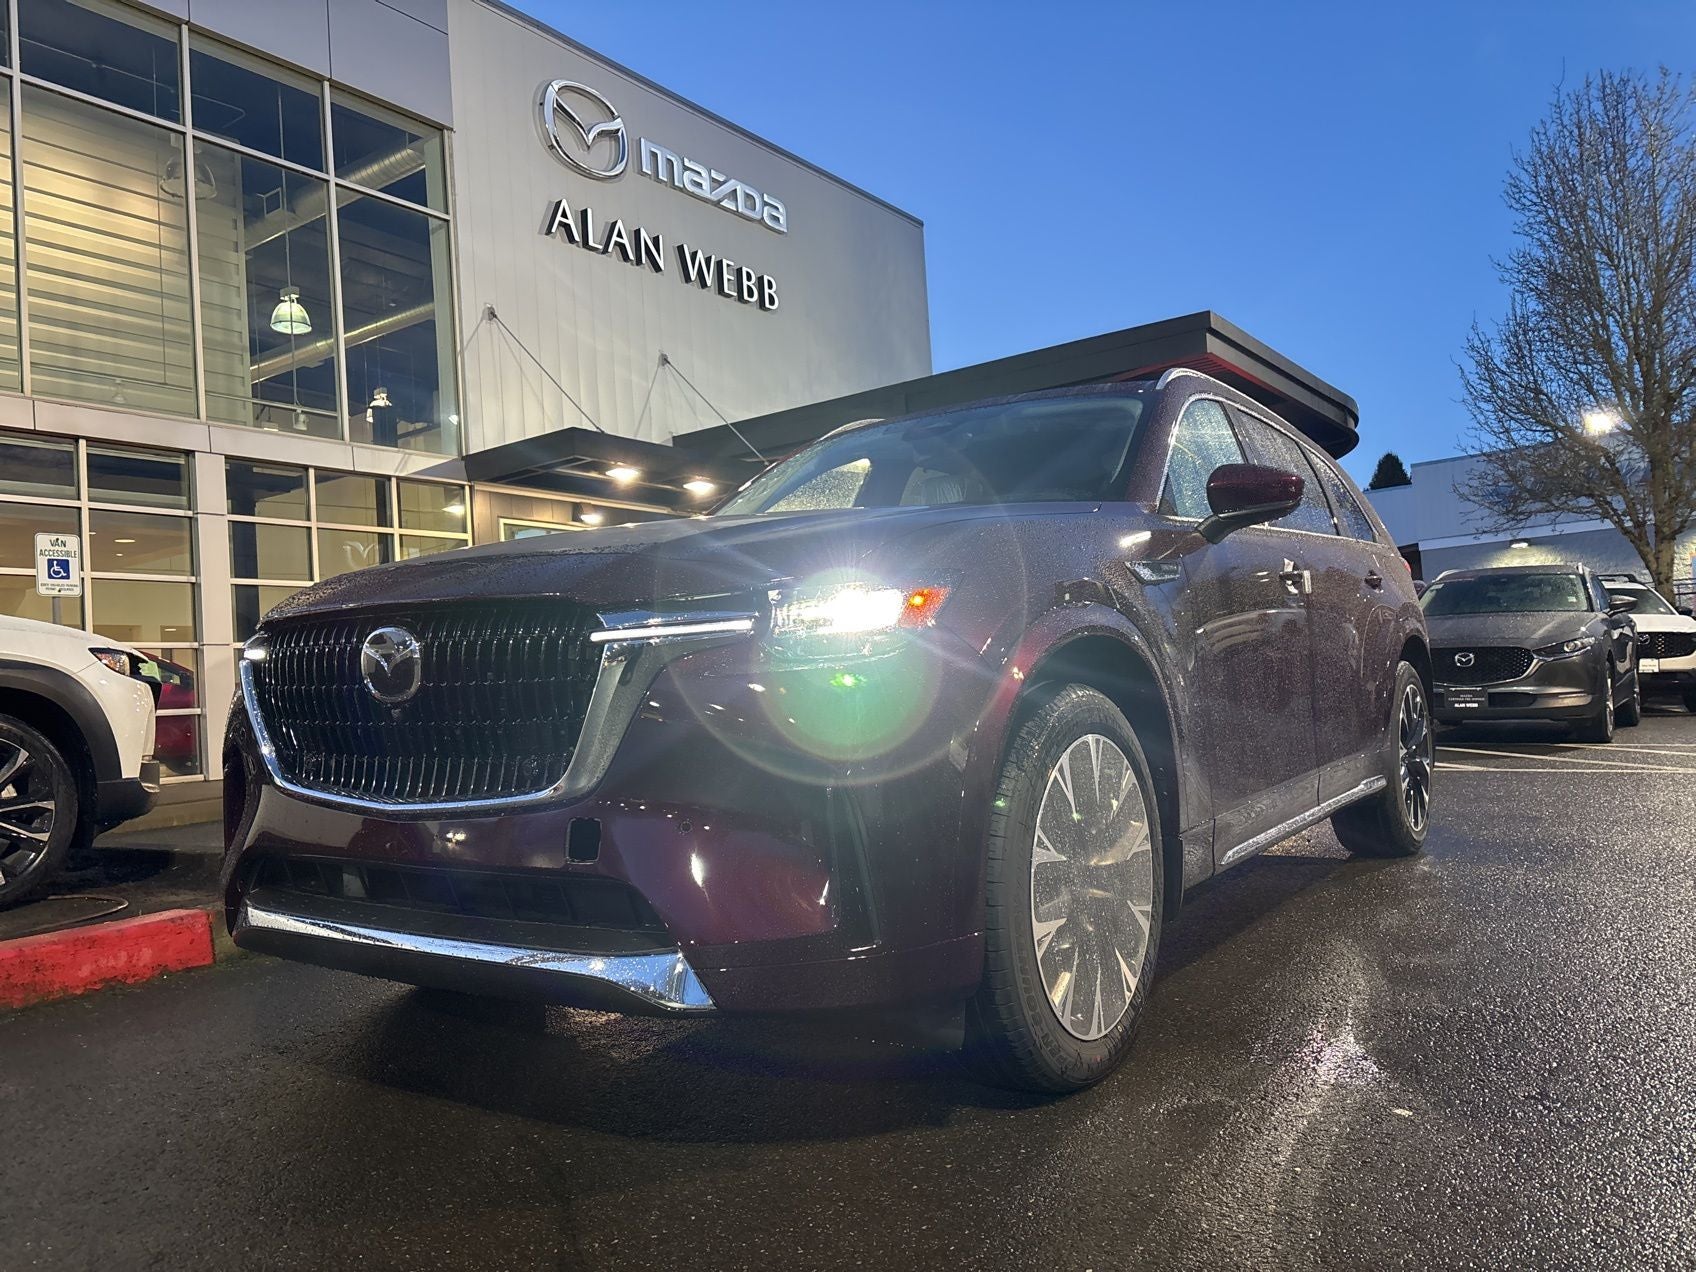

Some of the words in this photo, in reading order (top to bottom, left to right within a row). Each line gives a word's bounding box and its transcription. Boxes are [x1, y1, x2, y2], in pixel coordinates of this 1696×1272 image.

[546, 199, 665, 273] ALAN
[678, 243, 779, 311] WEBB
[49, 539, 67, 548] VAN
[39, 549, 78, 558] ACCESSIBLE
